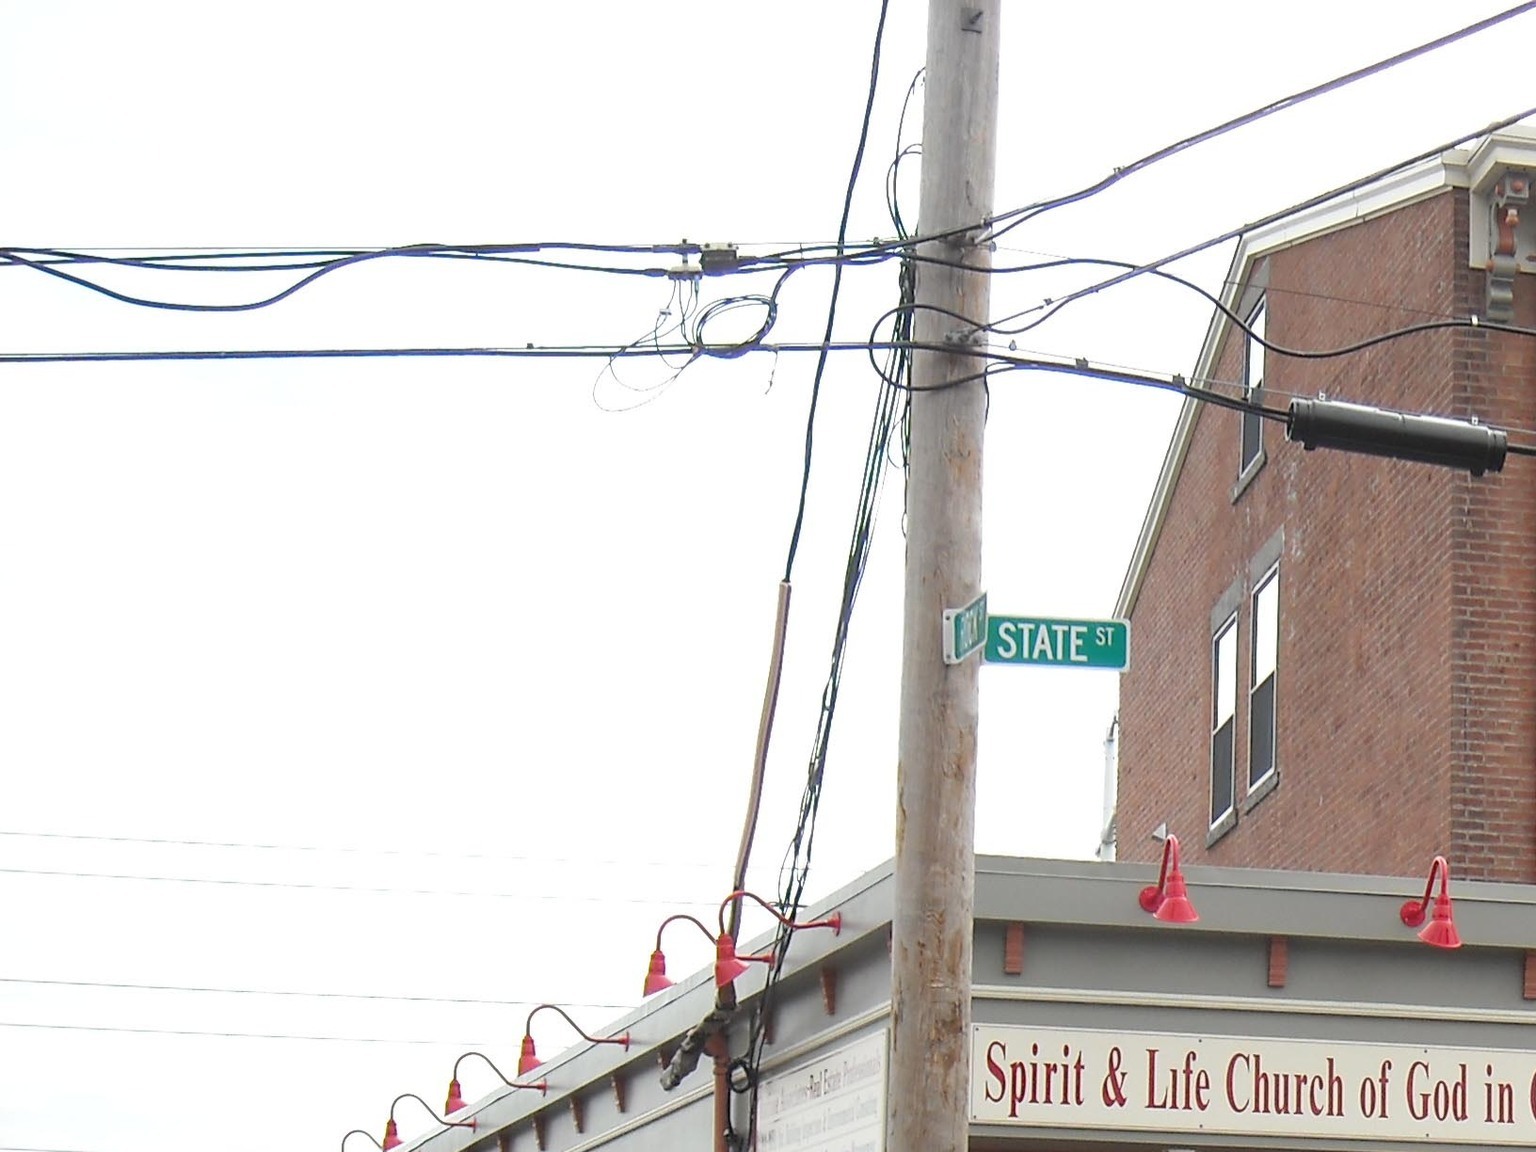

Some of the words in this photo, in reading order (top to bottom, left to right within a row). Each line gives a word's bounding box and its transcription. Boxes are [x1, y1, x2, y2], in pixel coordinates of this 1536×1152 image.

[997, 622, 1088, 662] STATE
[1095, 626, 1114, 646] ST
[985, 1040, 1085, 1118] Spirit
[1102, 1047, 1128, 1108] &
[1145, 1048, 1210, 1111] Life
[1225, 1053, 1344, 1118] Church
[1360, 1060, 1392, 1119] of
[1406, 1061, 1468, 1122] God
[1484, 1064, 1515, 1124] in
